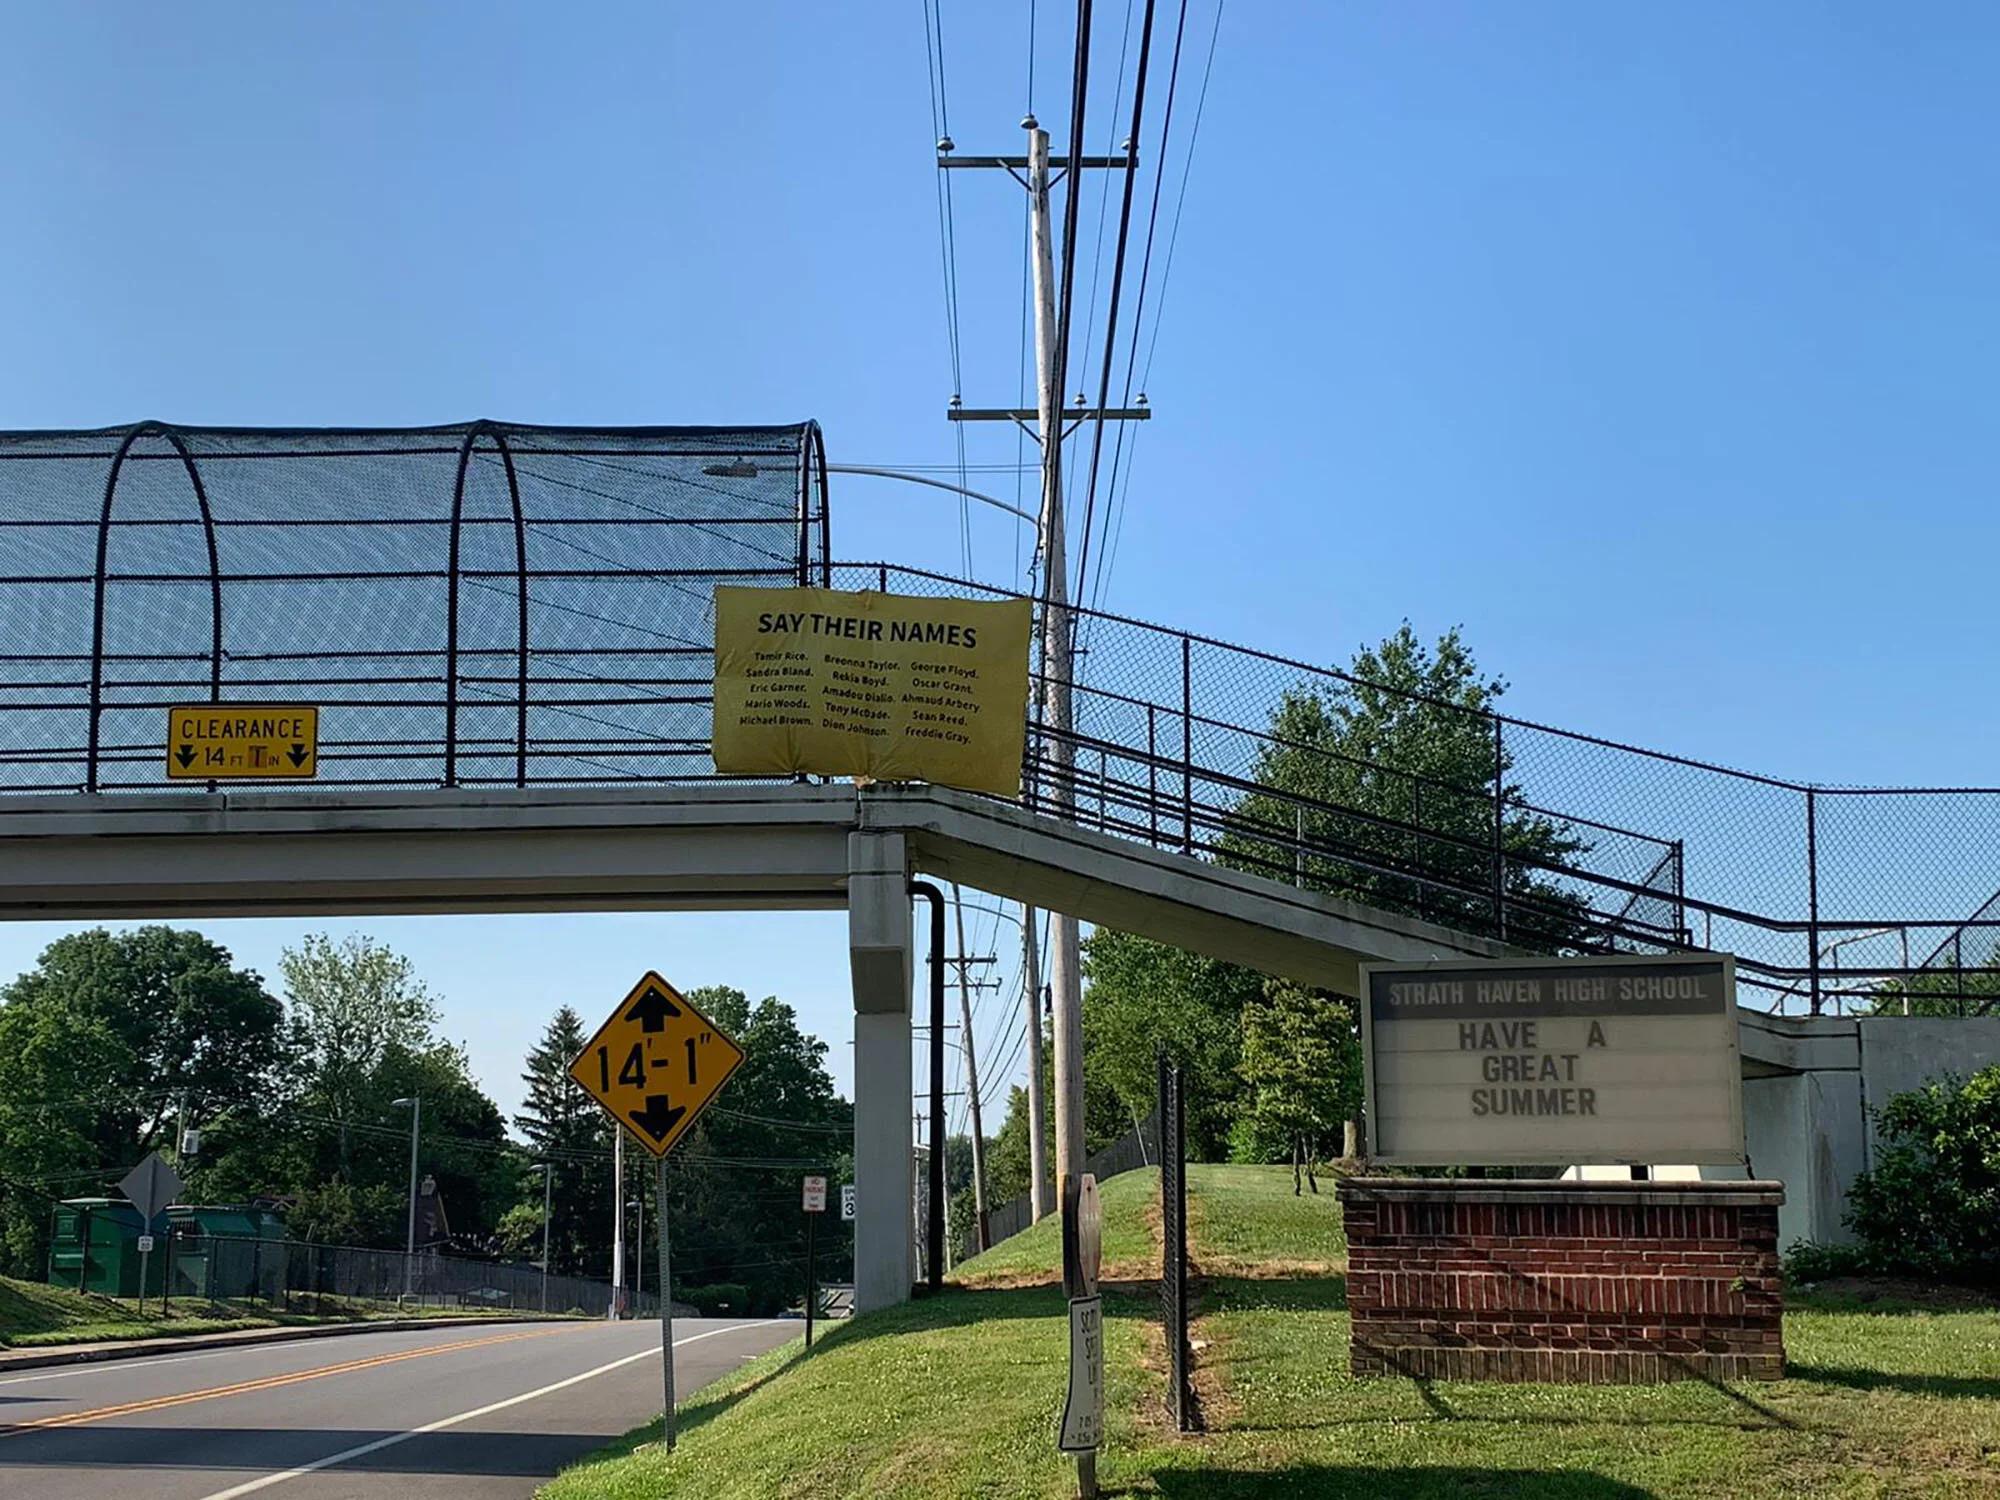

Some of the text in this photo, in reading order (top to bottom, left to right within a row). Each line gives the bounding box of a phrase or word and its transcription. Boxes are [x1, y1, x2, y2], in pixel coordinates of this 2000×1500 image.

[757, 613, 977, 649] SAY THEIR NAMES
[755, 652, 782, 661] Tamir
[824, 654, 865, 668] Breonna
[745, 667, 779, 678] Sandra
[910, 661, 946, 674] George
[832, 671, 860, 683] Rekia
[912, 677, 941, 688] Oscar
[749, 684, 768, 693] Eric
[822, 686, 863, 700] Amadou
[901, 693, 944, 705] Ahmaud
[824, 702, 849, 716] Tony
[912, 710, 937, 721] Sean
[739, 715, 777, 725] Michael
[822, 718, 846, 730] Dion
[182, 719, 304, 739] CLEARANCE
[905, 726, 944, 739] Freddie
[205, 746, 224, 766] 14
[230, 755, 243, 767] FT
[268, 755, 280, 766] IN
[1389, 975, 1707, 1006] STRATH HAVEN HIGH SCHOOL
[1458, 1021, 1606, 1049] HAVE A
[1482, 1054, 1579, 1082] GREAT
[1471, 1087, 1596, 1116] SUMMER
[845, 1202, 855, 1216] 3
